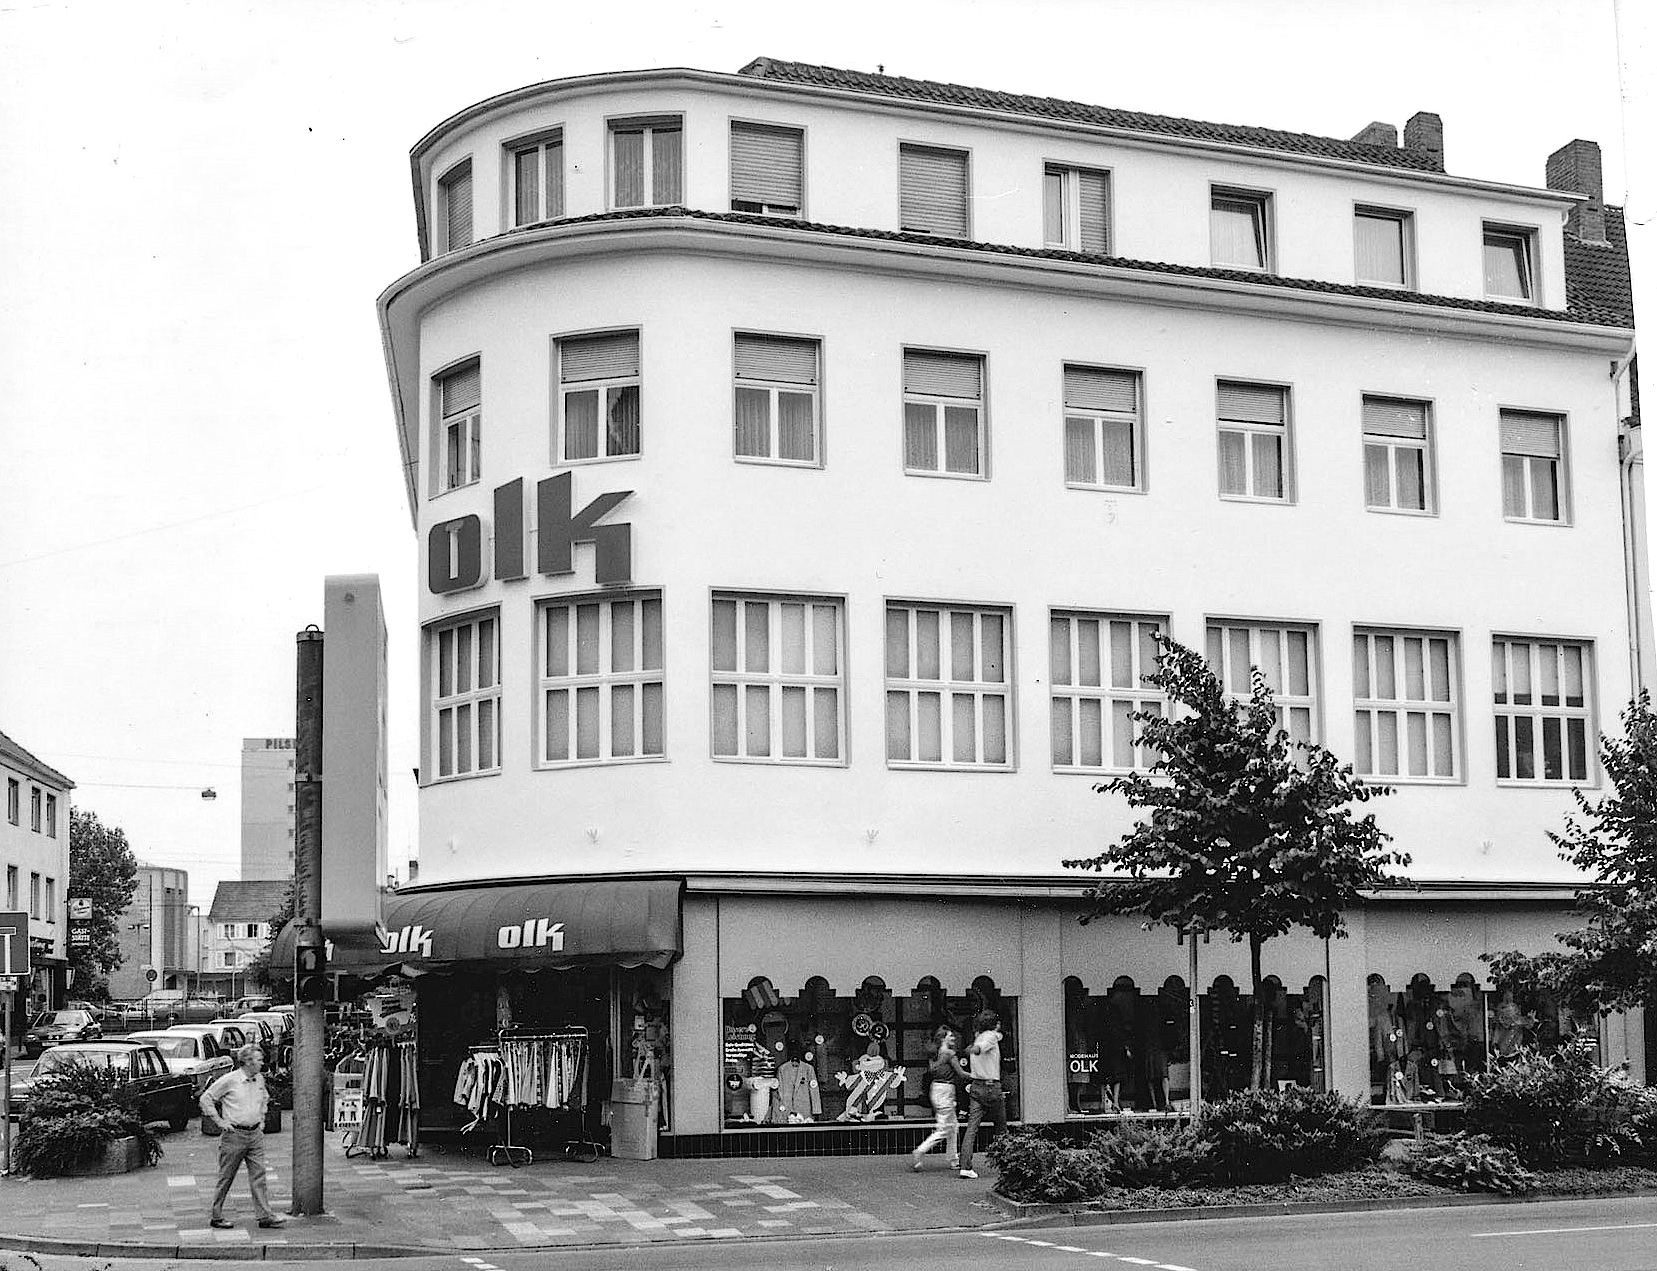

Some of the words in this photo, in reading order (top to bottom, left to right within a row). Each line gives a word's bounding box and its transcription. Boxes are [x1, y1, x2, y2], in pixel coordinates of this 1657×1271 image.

[428, 470, 635, 595] olk
[498, 917, 565, 951] olk
[1070, 1060, 1099, 1073] OLK
